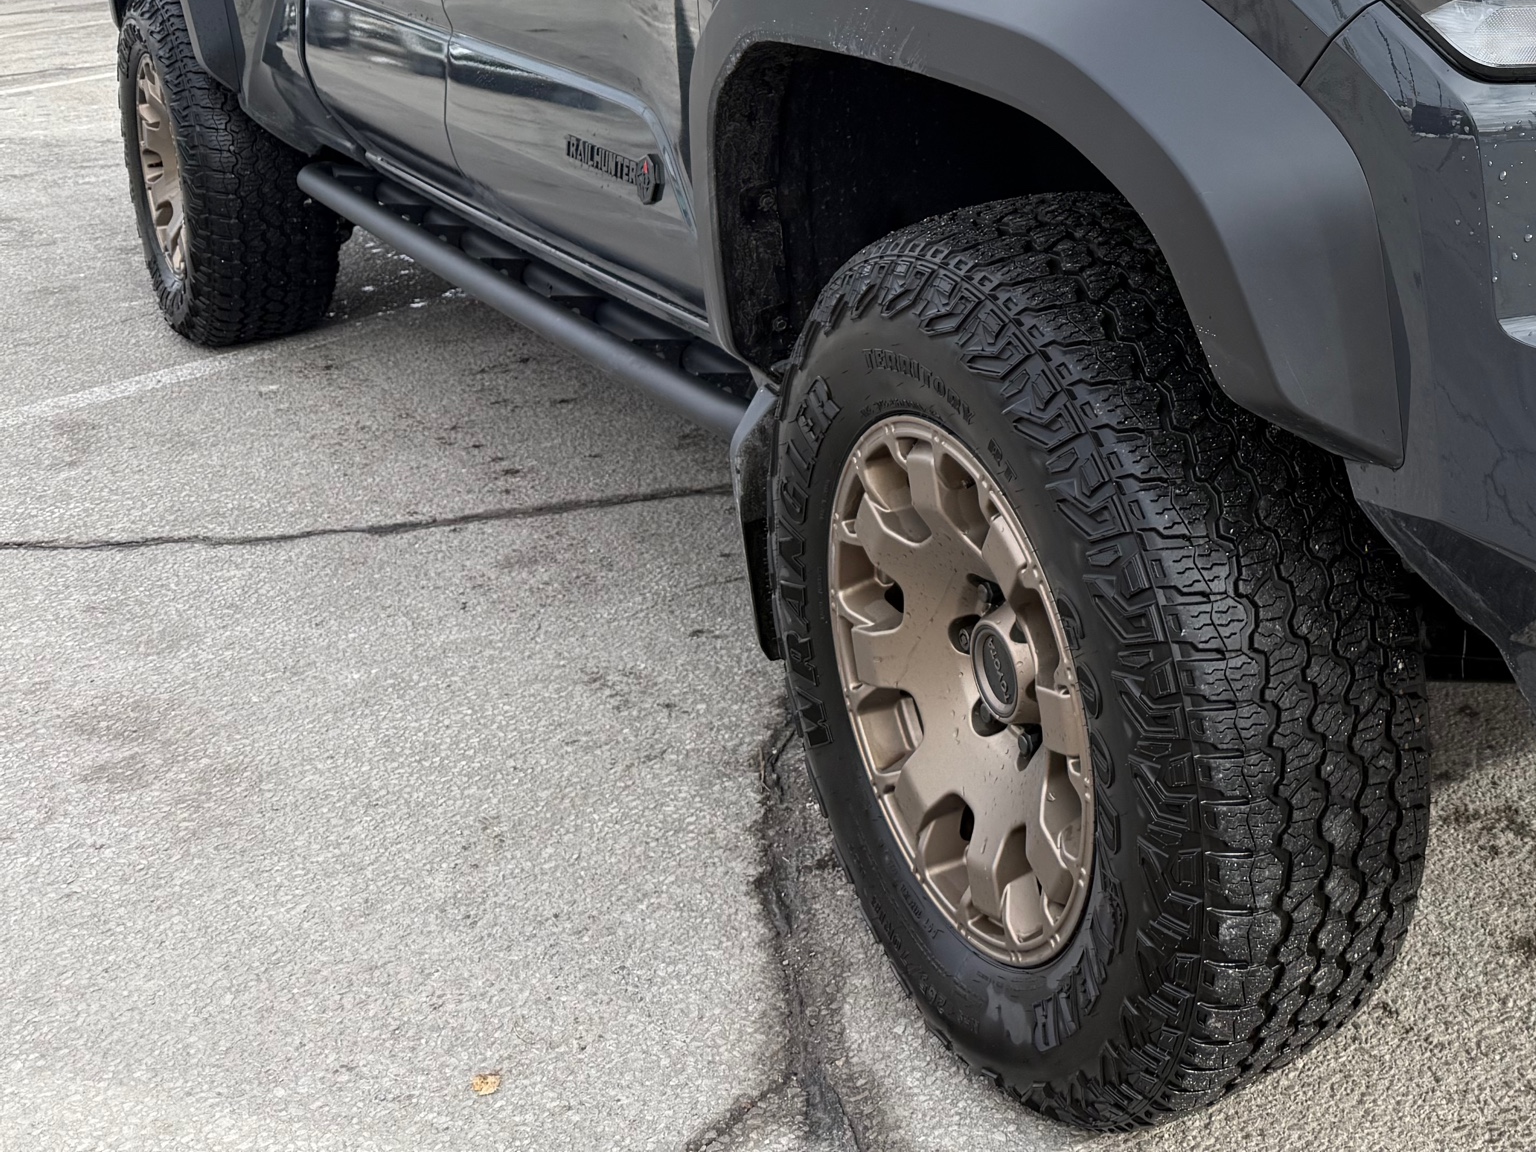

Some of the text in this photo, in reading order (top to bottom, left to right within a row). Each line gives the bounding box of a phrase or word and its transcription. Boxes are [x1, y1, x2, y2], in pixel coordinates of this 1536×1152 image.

[565, 134, 638, 186] TRAILHUNTER
[863, 348, 975, 425] TERRITORY
[987, 637, 1010, 702] TOYOTA
